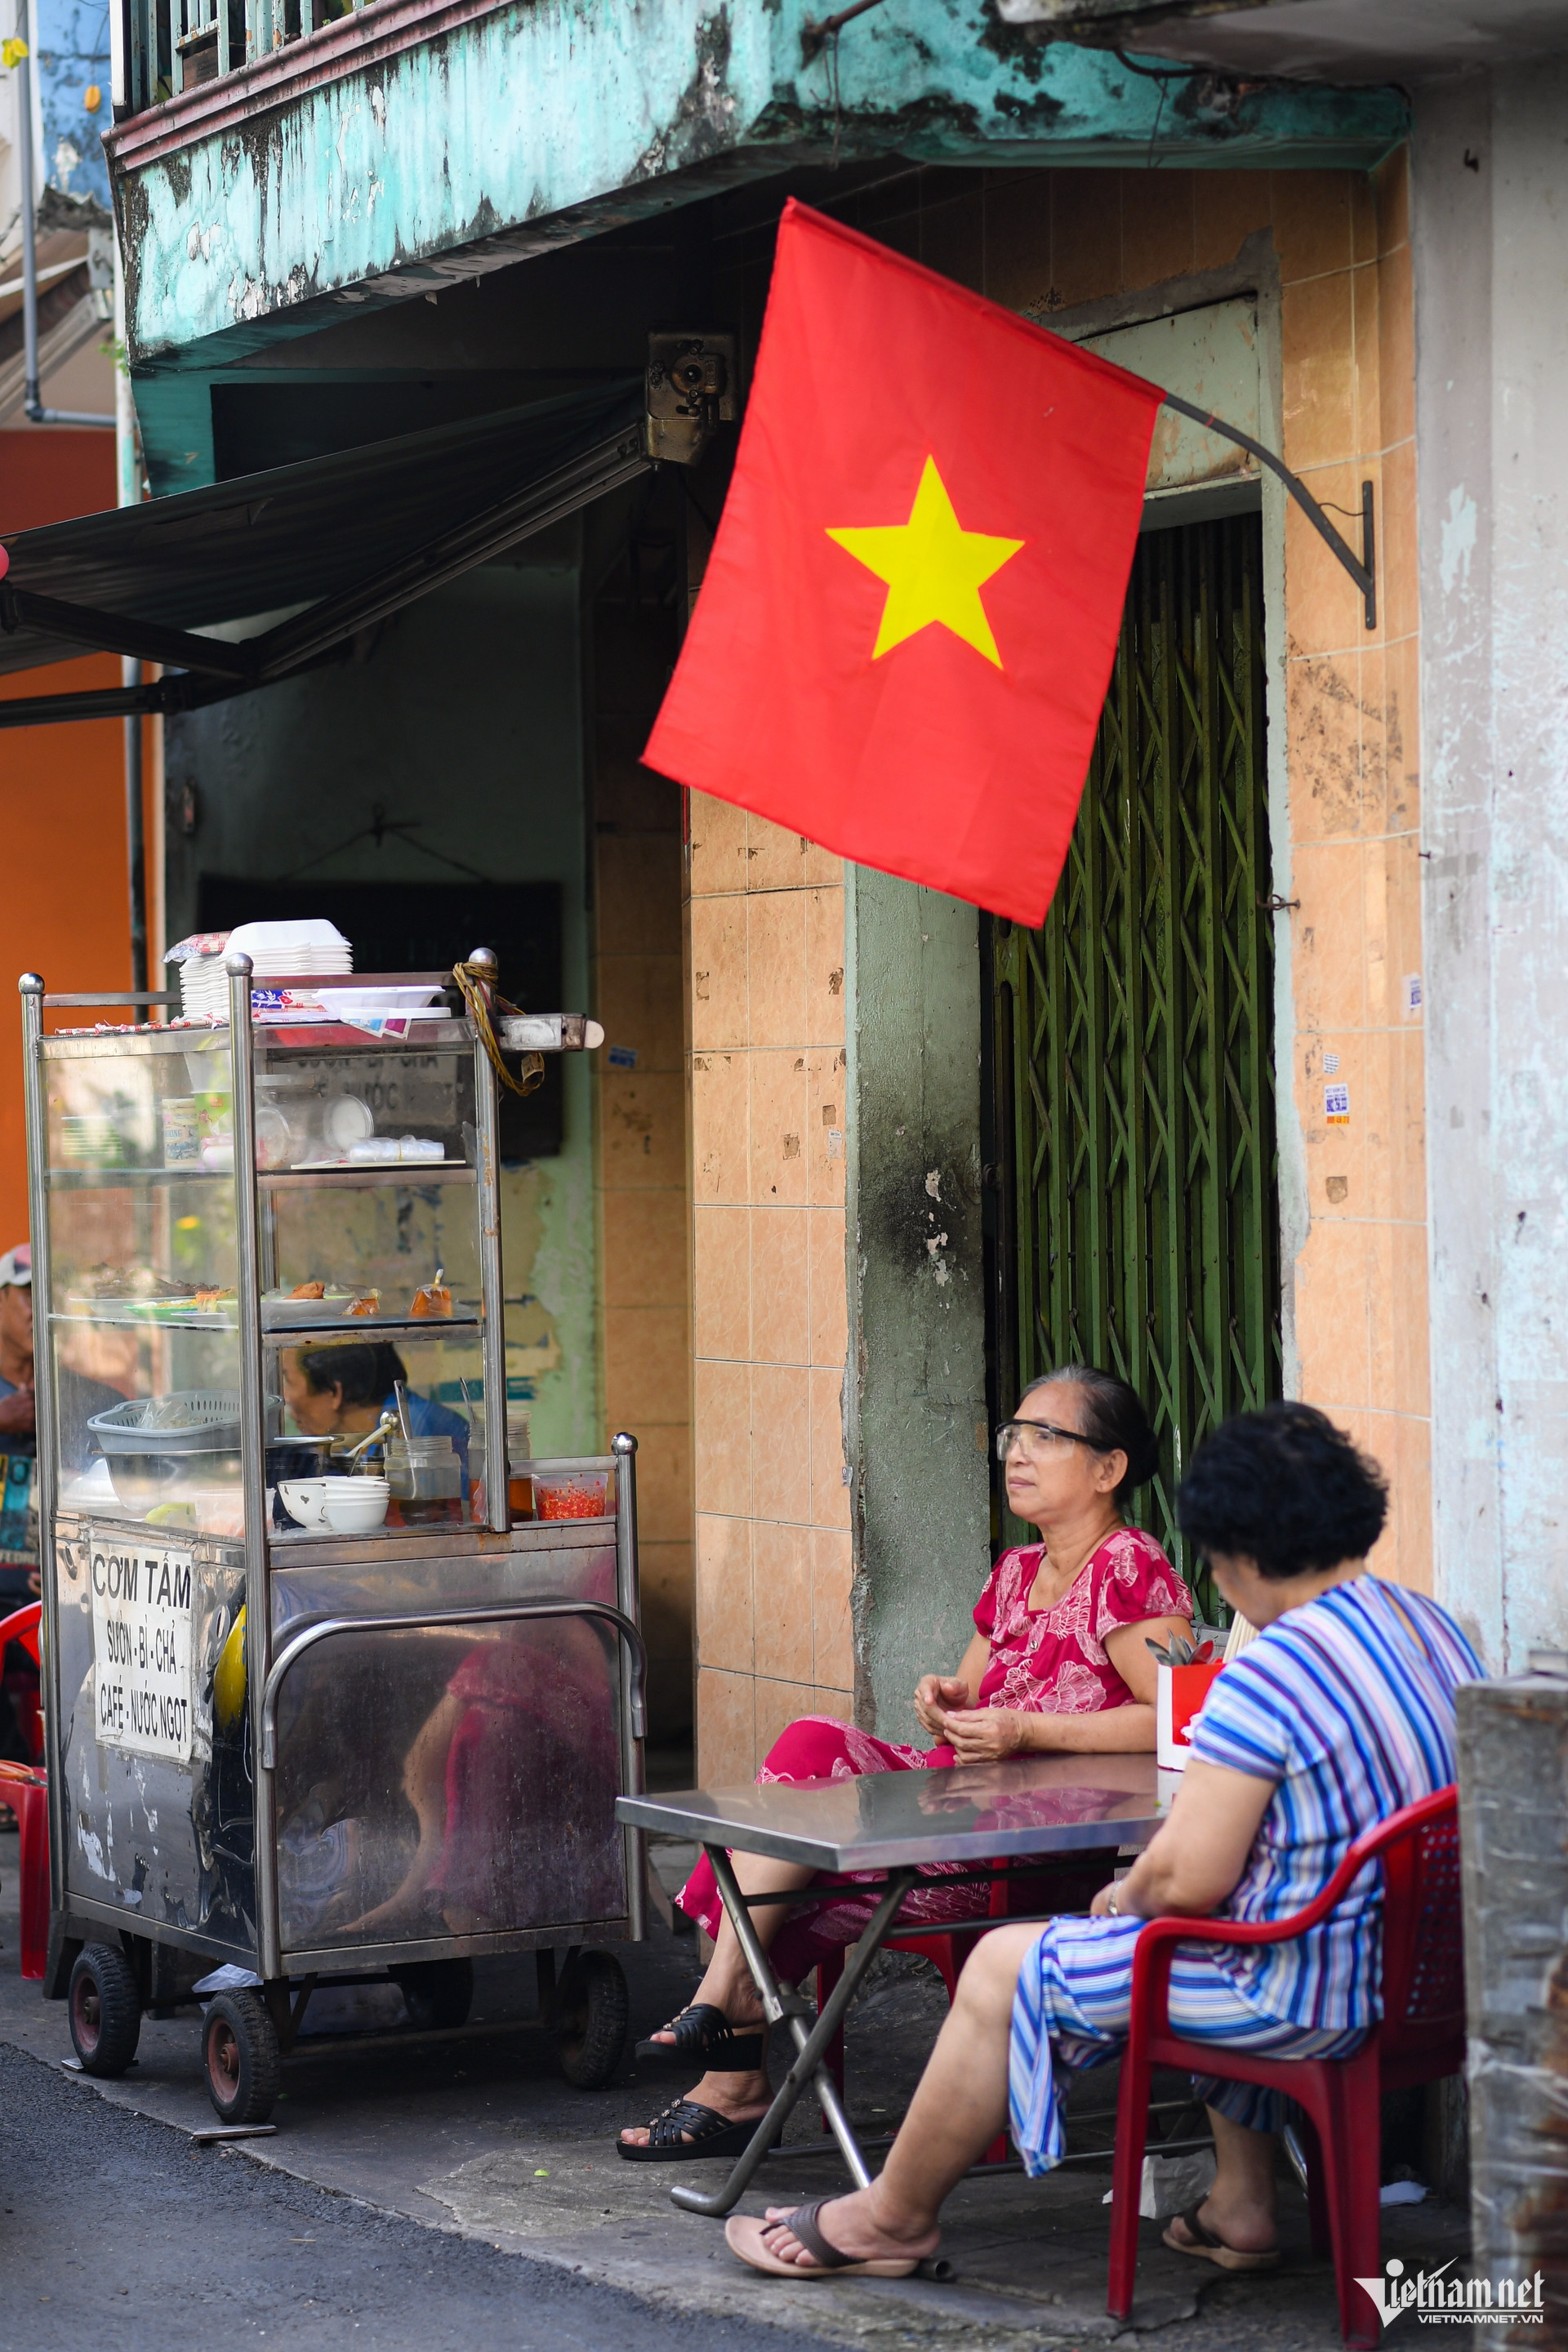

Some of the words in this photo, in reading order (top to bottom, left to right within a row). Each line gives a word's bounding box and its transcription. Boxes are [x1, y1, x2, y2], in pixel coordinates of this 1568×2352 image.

[93, 1553, 138, 1602] CƠM
[107, 1610, 132, 1666] SƯỜN
[139, 1614, 149, 1669] BÌ
[155, 1619, 177, 1674] CHẢ
[100, 1674, 123, 1729] CAFÉ
[131, 1680, 158, 1737] NƯỚC
[159, 1695, 187, 1753] NGỌT
